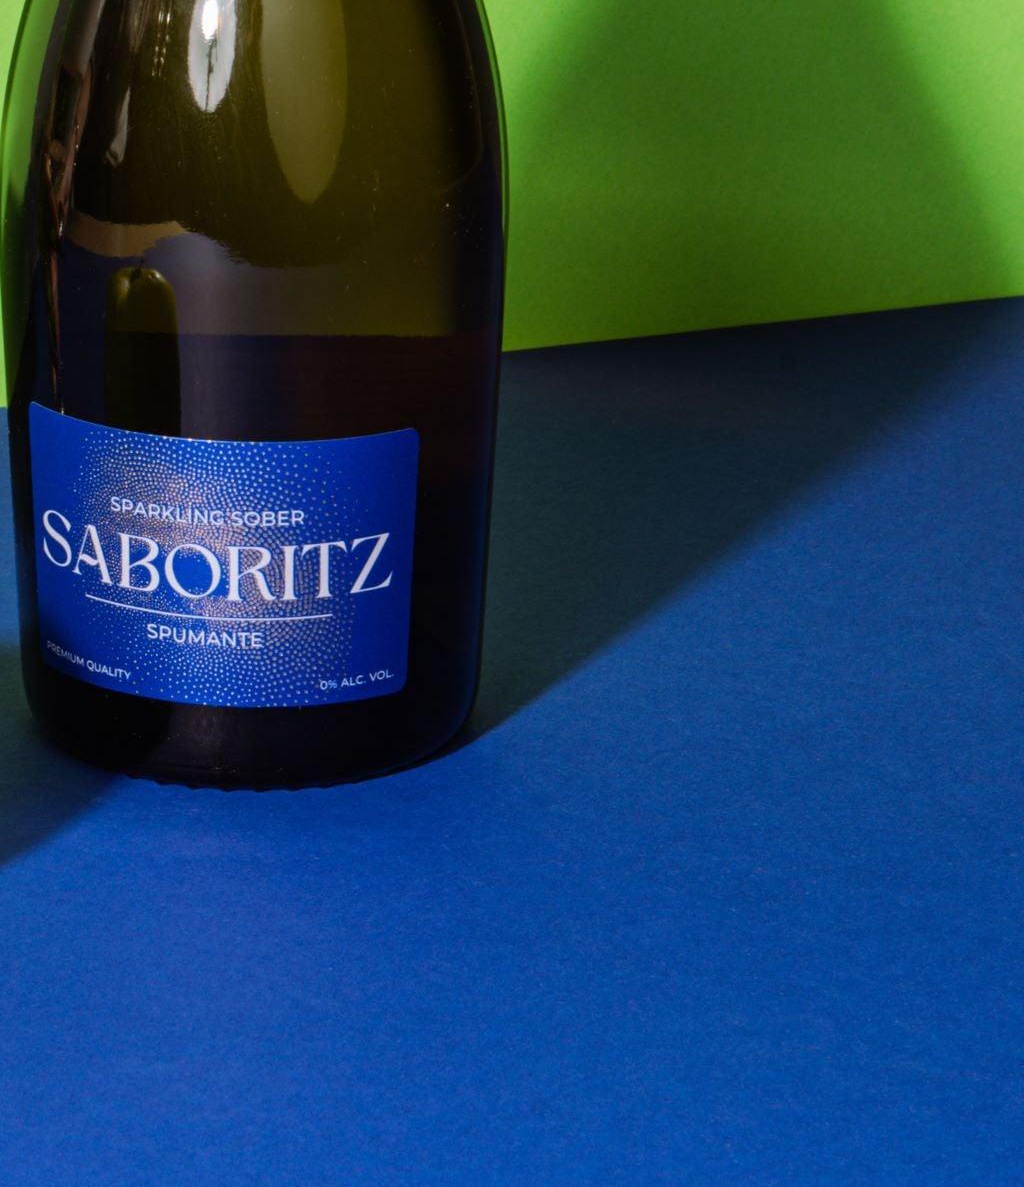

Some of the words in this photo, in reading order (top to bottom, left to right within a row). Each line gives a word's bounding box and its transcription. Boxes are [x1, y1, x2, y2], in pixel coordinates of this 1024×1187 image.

[110, 496, 224, 526] SPARKLING
[230, 509, 305, 528] SOBER
[42, 509, 393, 601] SABORITZ
[147, 623, 264, 649] SPUMANTE
[47, 641, 85, 667] PREMIUM
[86, 660, 131, 680] QUALITY
[320, 680, 337, 690] 0%
